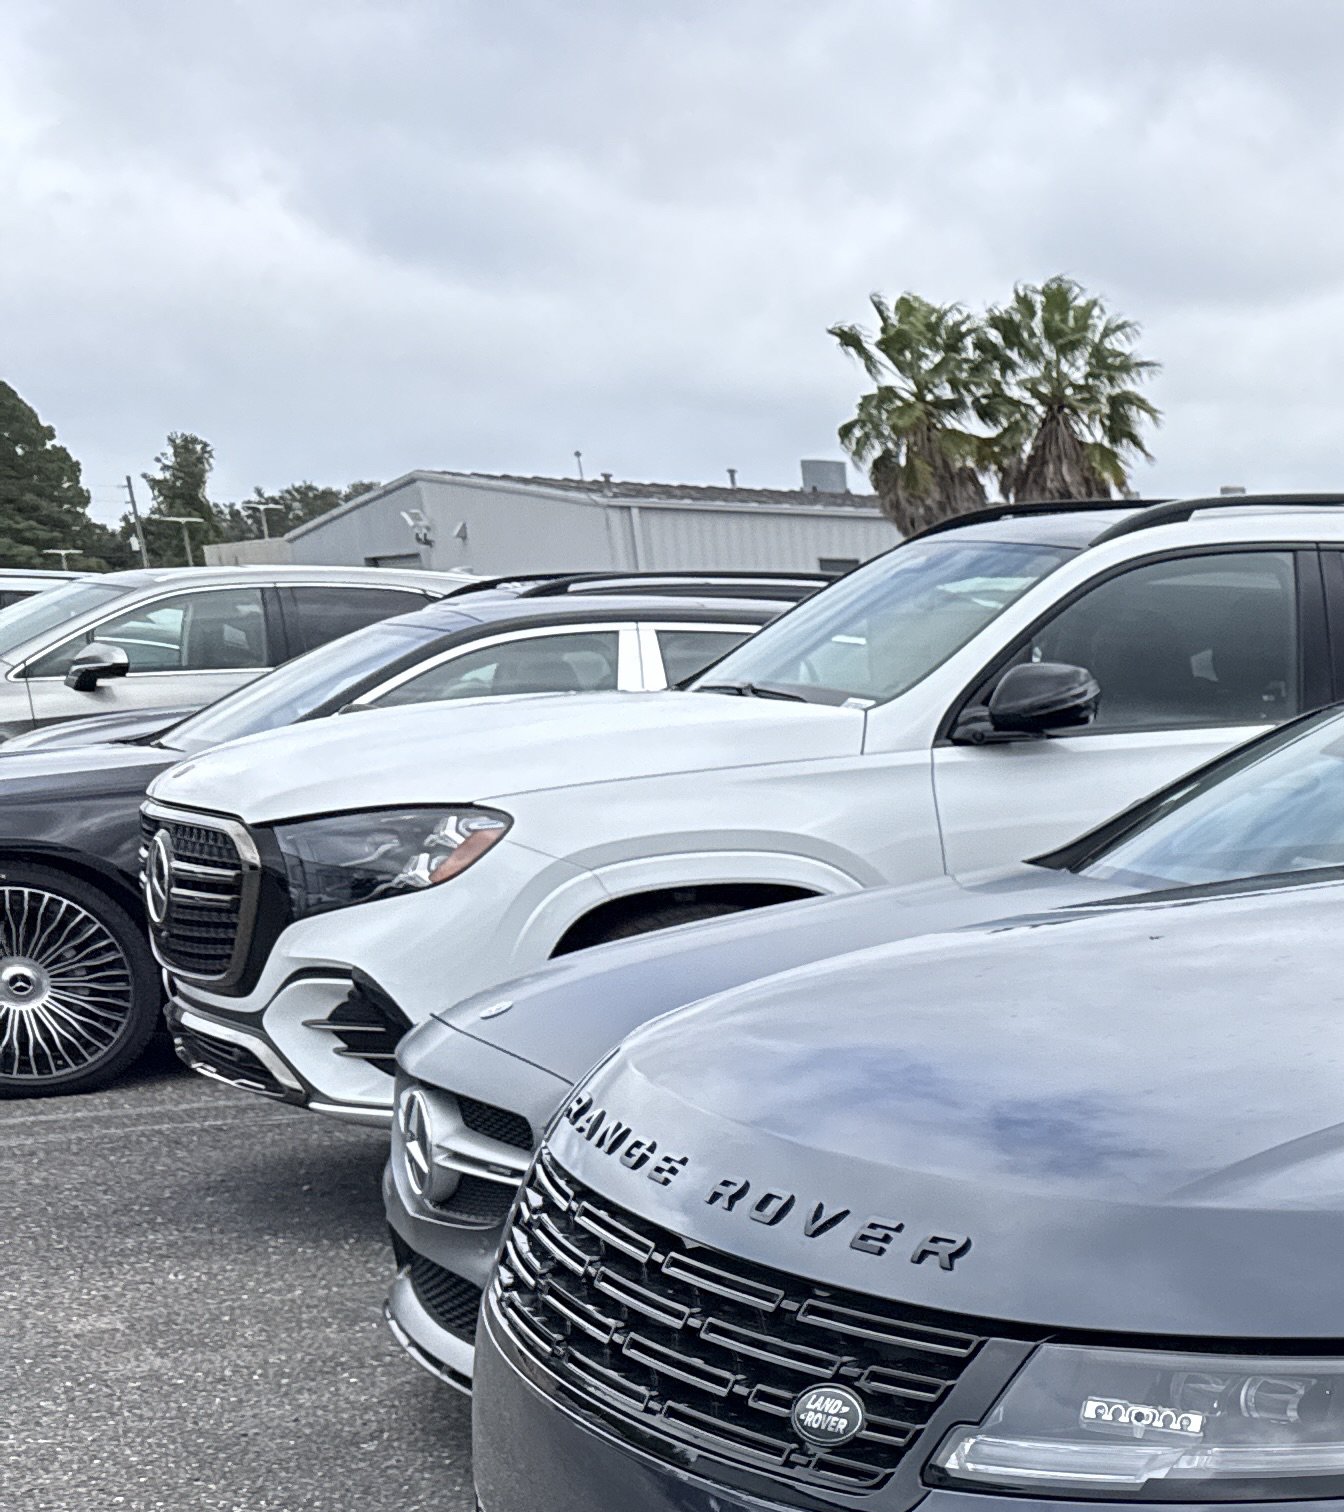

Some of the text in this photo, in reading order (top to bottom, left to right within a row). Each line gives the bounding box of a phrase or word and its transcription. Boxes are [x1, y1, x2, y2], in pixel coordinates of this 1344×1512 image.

[563, 1091, 972, 1272] RANGE ROVER
[805, 1394, 843, 1415] LAND
[803, 1410, 848, 1435] ROVER
